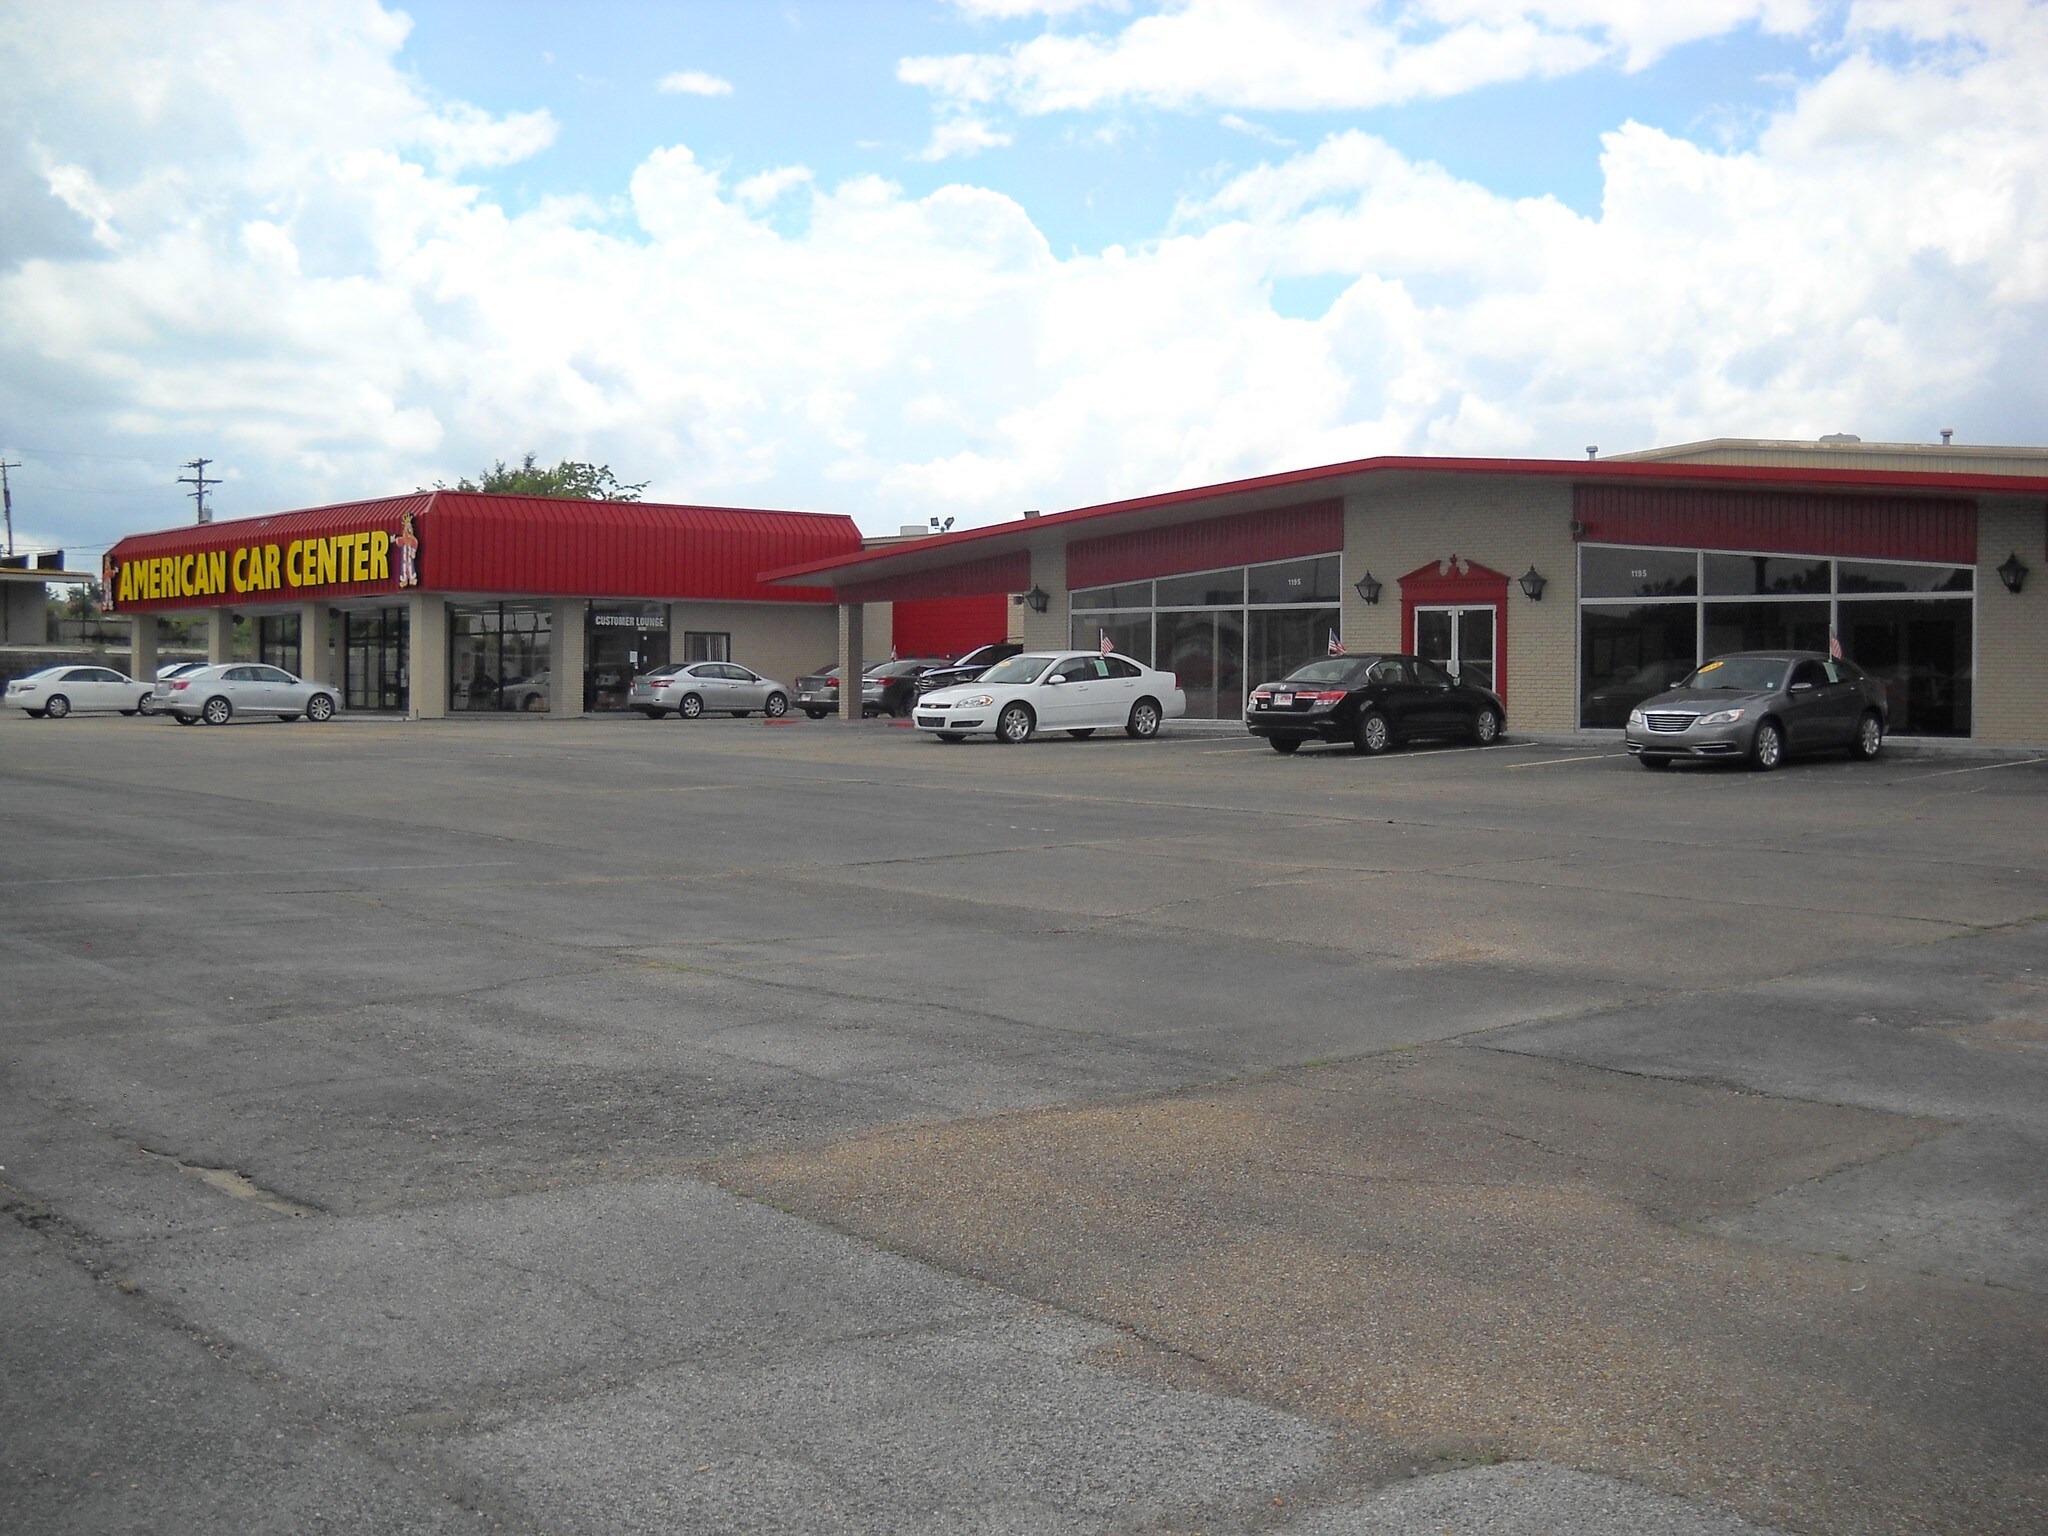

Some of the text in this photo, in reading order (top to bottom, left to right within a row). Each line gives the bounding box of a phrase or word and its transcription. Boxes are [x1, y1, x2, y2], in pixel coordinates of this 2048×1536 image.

[118, 530, 389, 601] AMERICAN CAR CENTER
[1631, 570, 1647, 578] 1195
[1288, 578, 1302, 586] 1195
[595, 615, 664, 627] CUSTOMER LOUNGE
